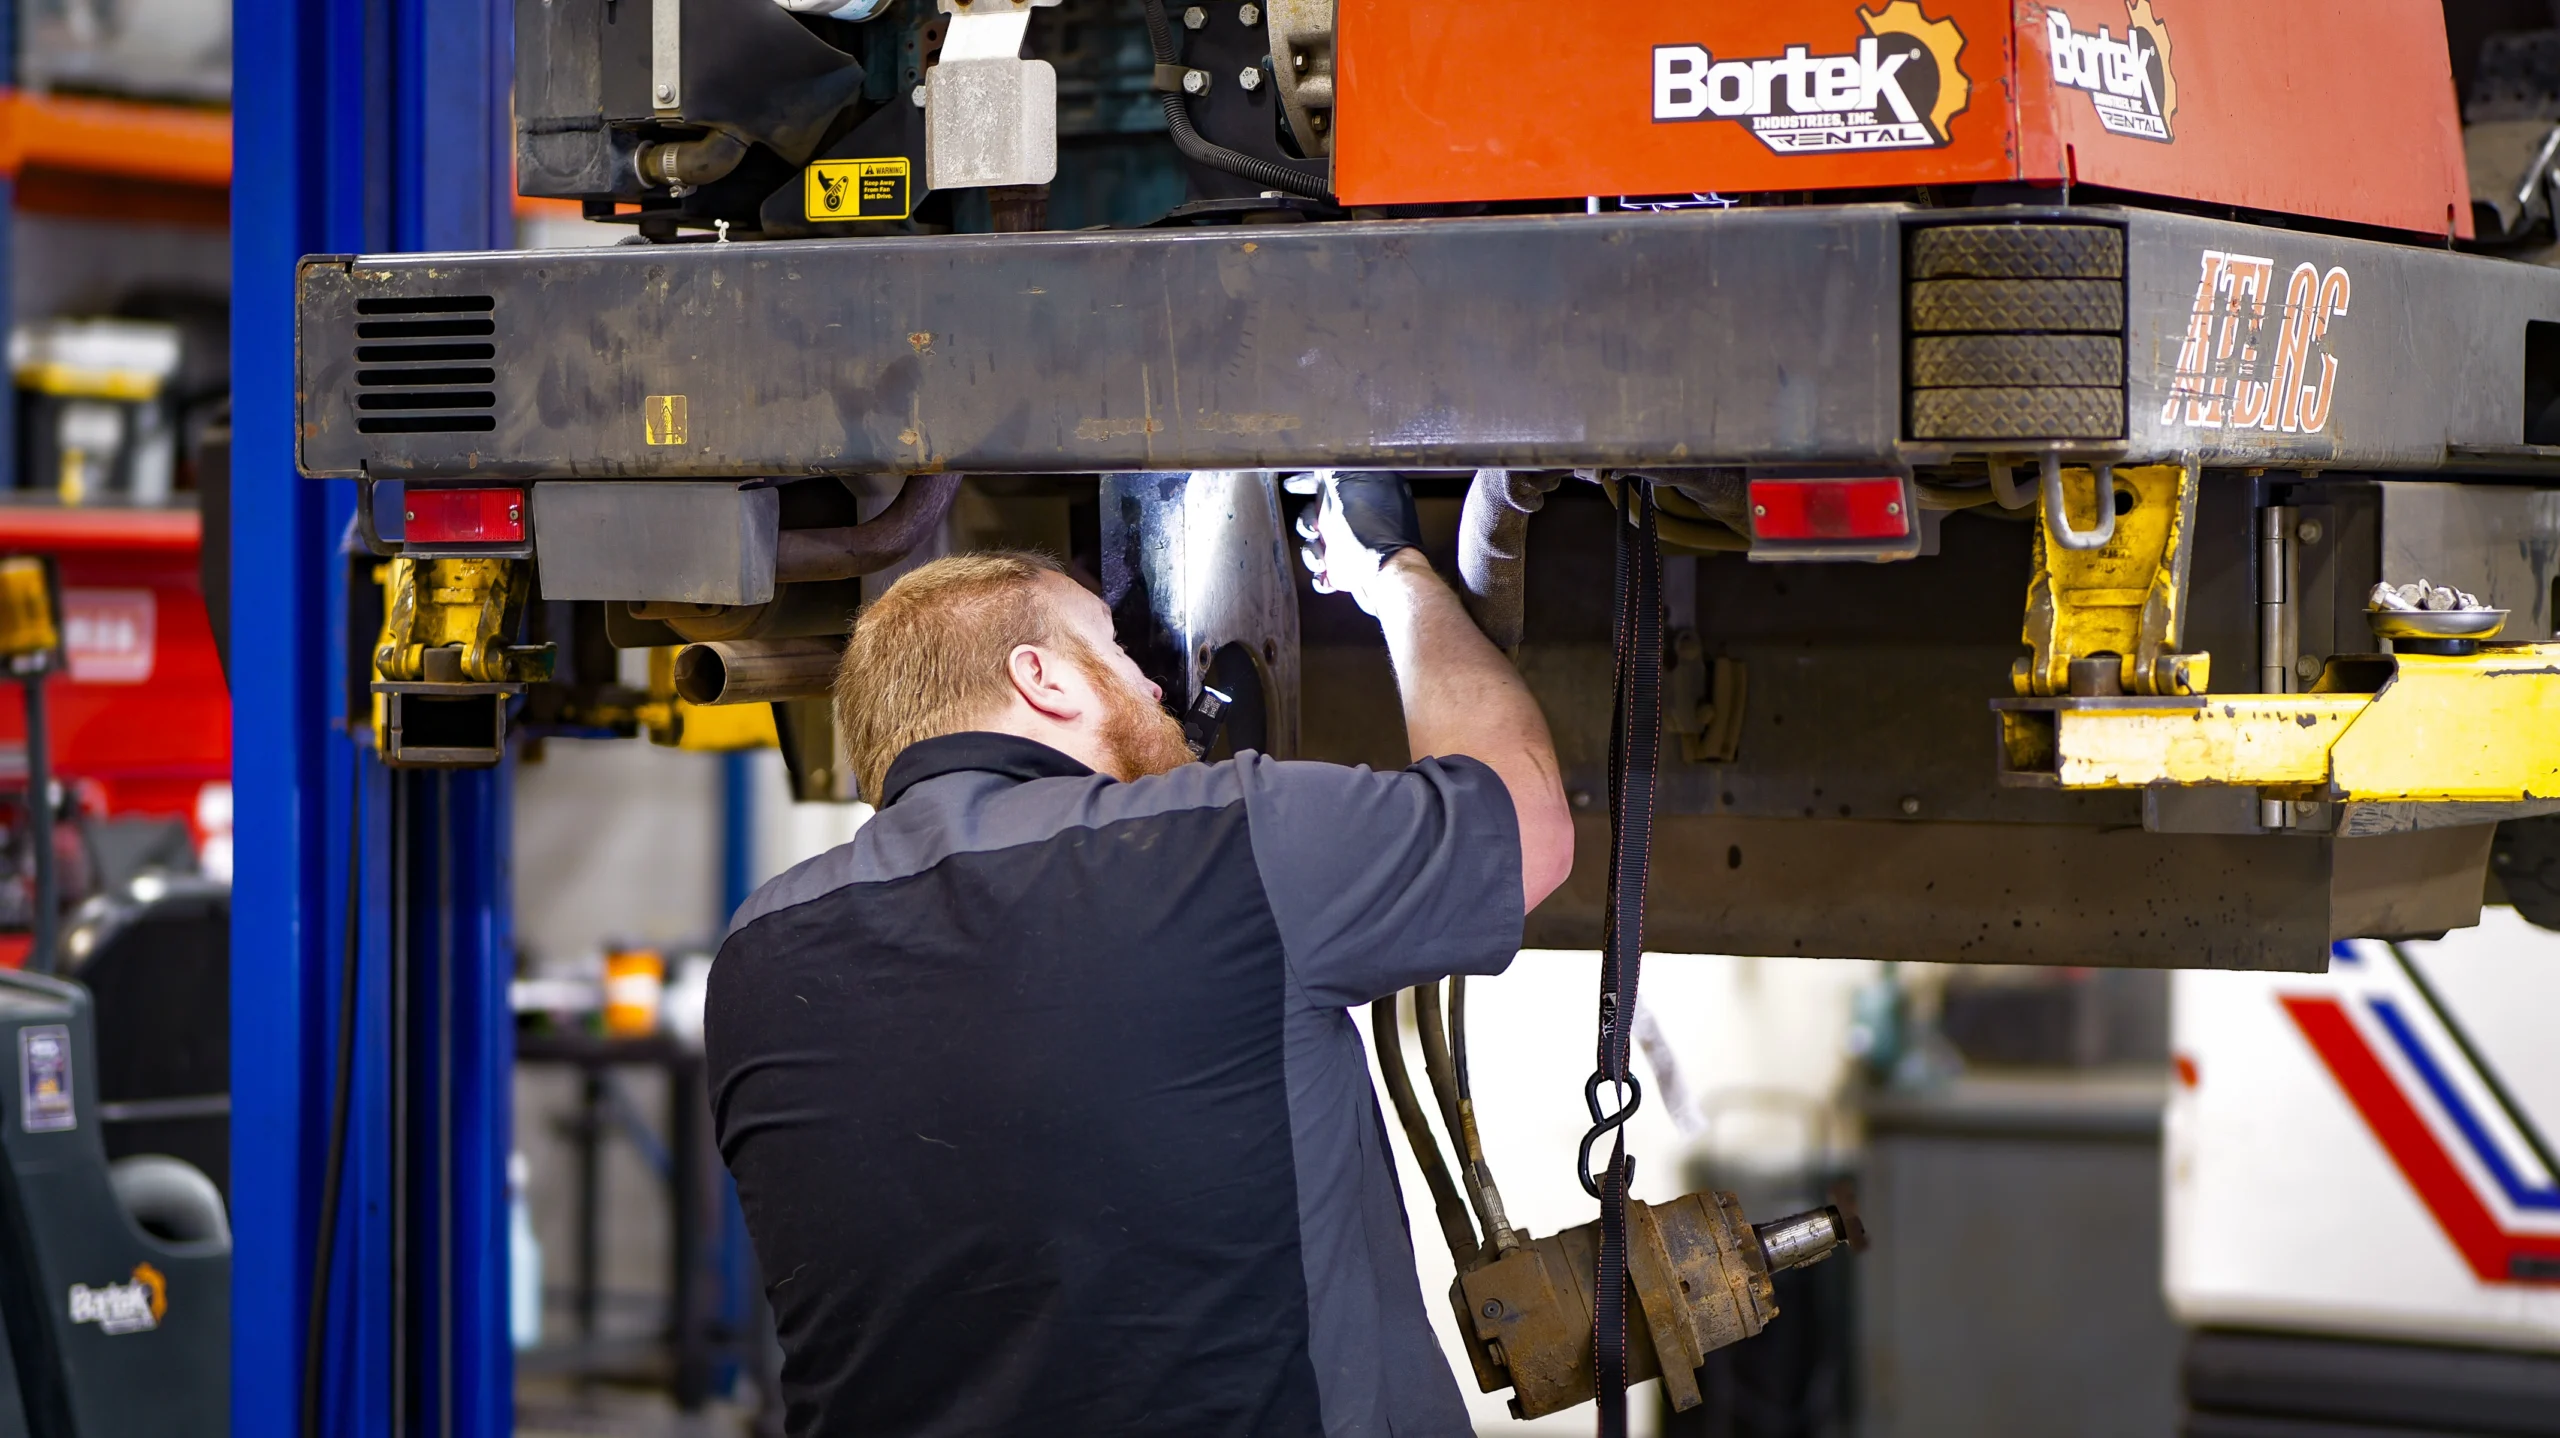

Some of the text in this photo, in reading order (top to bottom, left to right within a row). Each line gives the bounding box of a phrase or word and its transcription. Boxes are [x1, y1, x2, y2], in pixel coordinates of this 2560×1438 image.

[2046, 9, 2160, 116] Bortek
[1654, 37, 1920, 122] Bortek
[1752, 111, 1878, 130] INDUSTRIES, INC.
[2102, 110, 2163, 134] RENTAL
[1767, 128, 1925, 147] RENTAL
[875, 166, 904, 175] WARNING
[879, 179, 896, 187] Away
